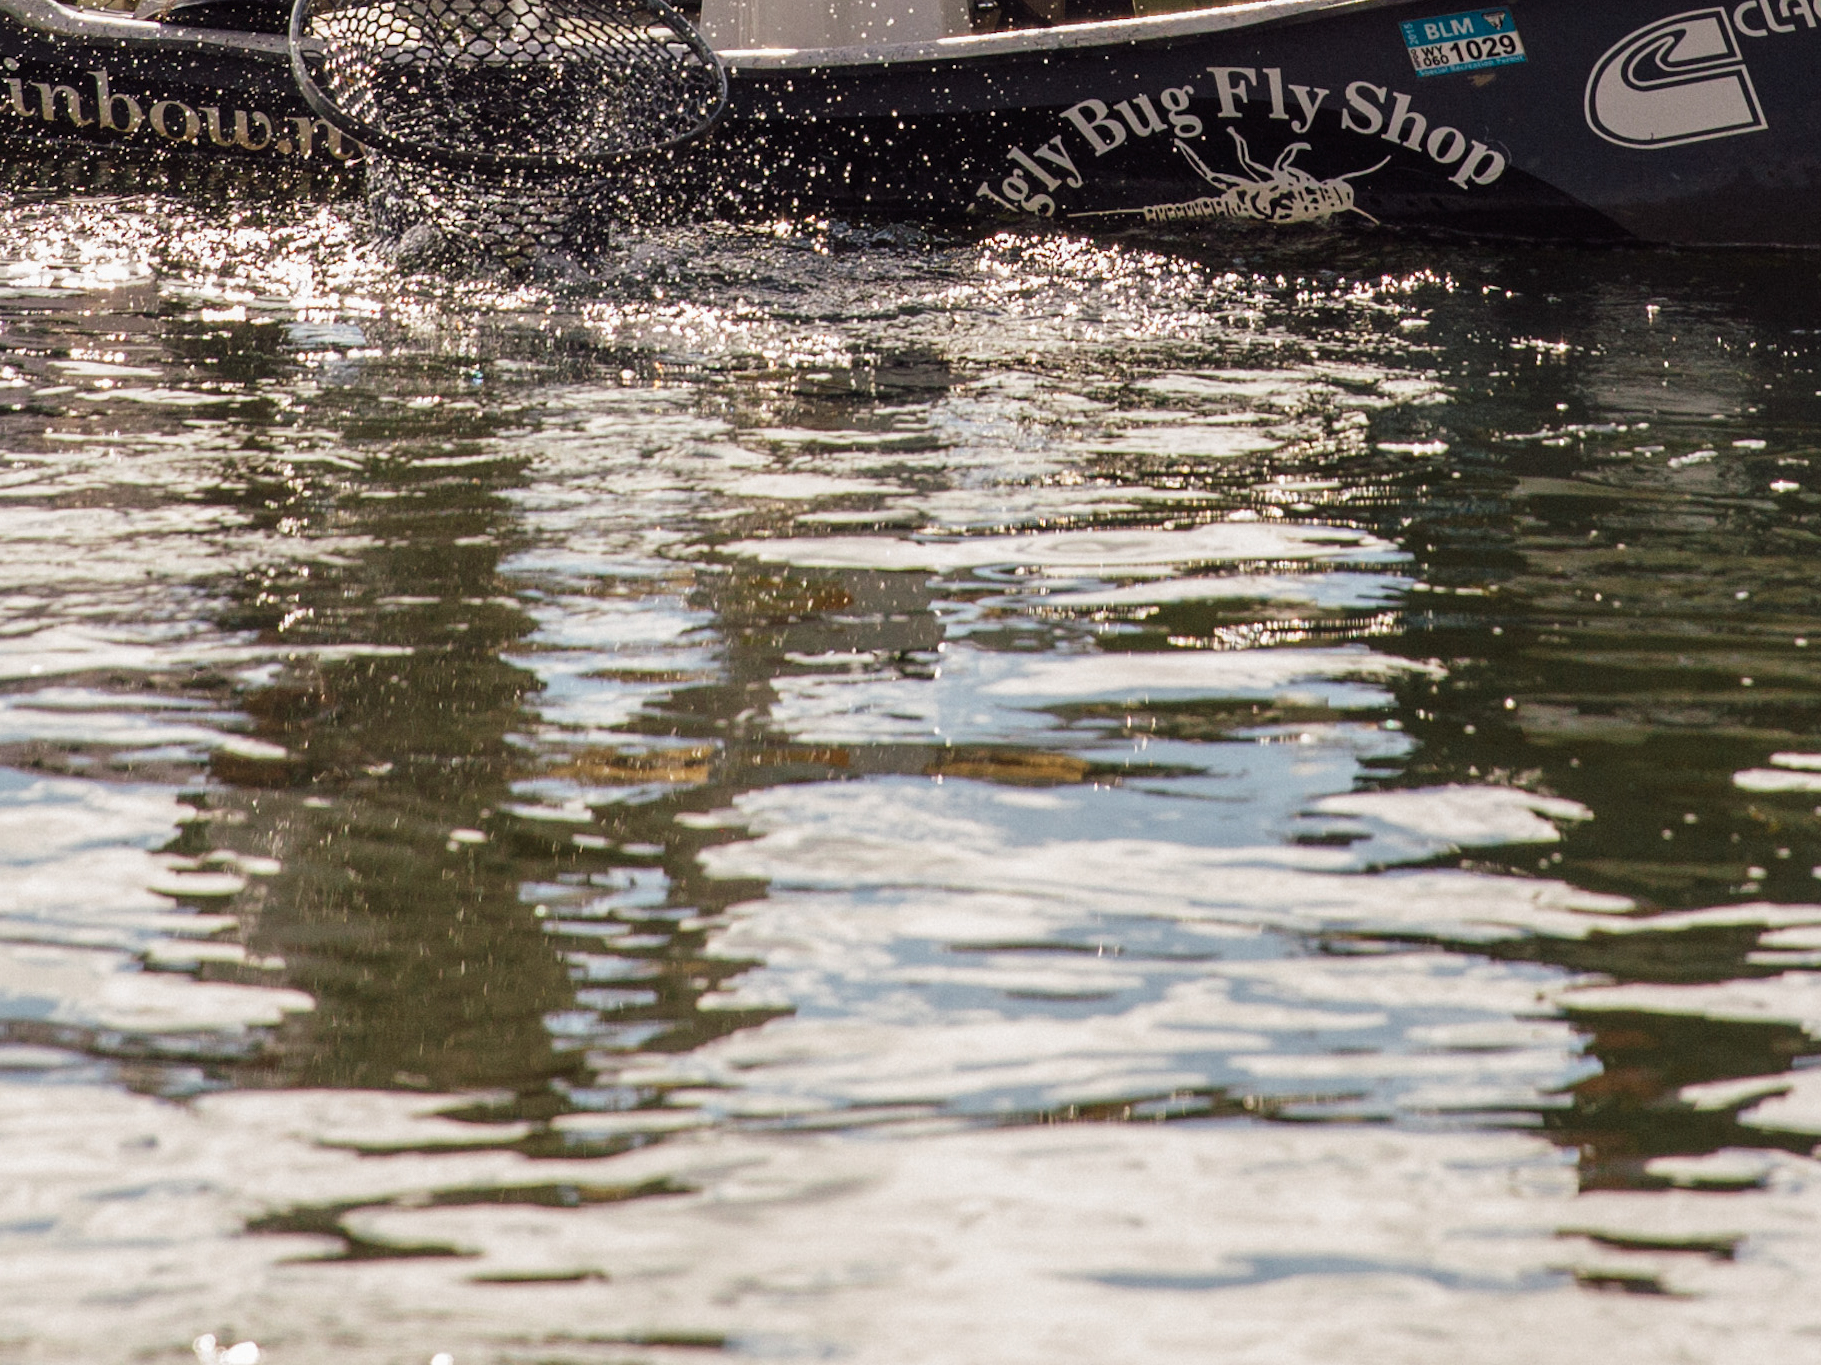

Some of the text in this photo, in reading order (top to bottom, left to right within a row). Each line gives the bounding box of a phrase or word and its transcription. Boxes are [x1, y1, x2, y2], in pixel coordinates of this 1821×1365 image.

[1423, 17, 1475, 40] BLM
[1420, 45, 1443, 57] WY
[1450, 34, 1516, 62] 1029
[1059, 85, 1203, 157] Bug
[1207, 66, 1331, 133] Fly
[1340, 79, 1507, 189] Shop
